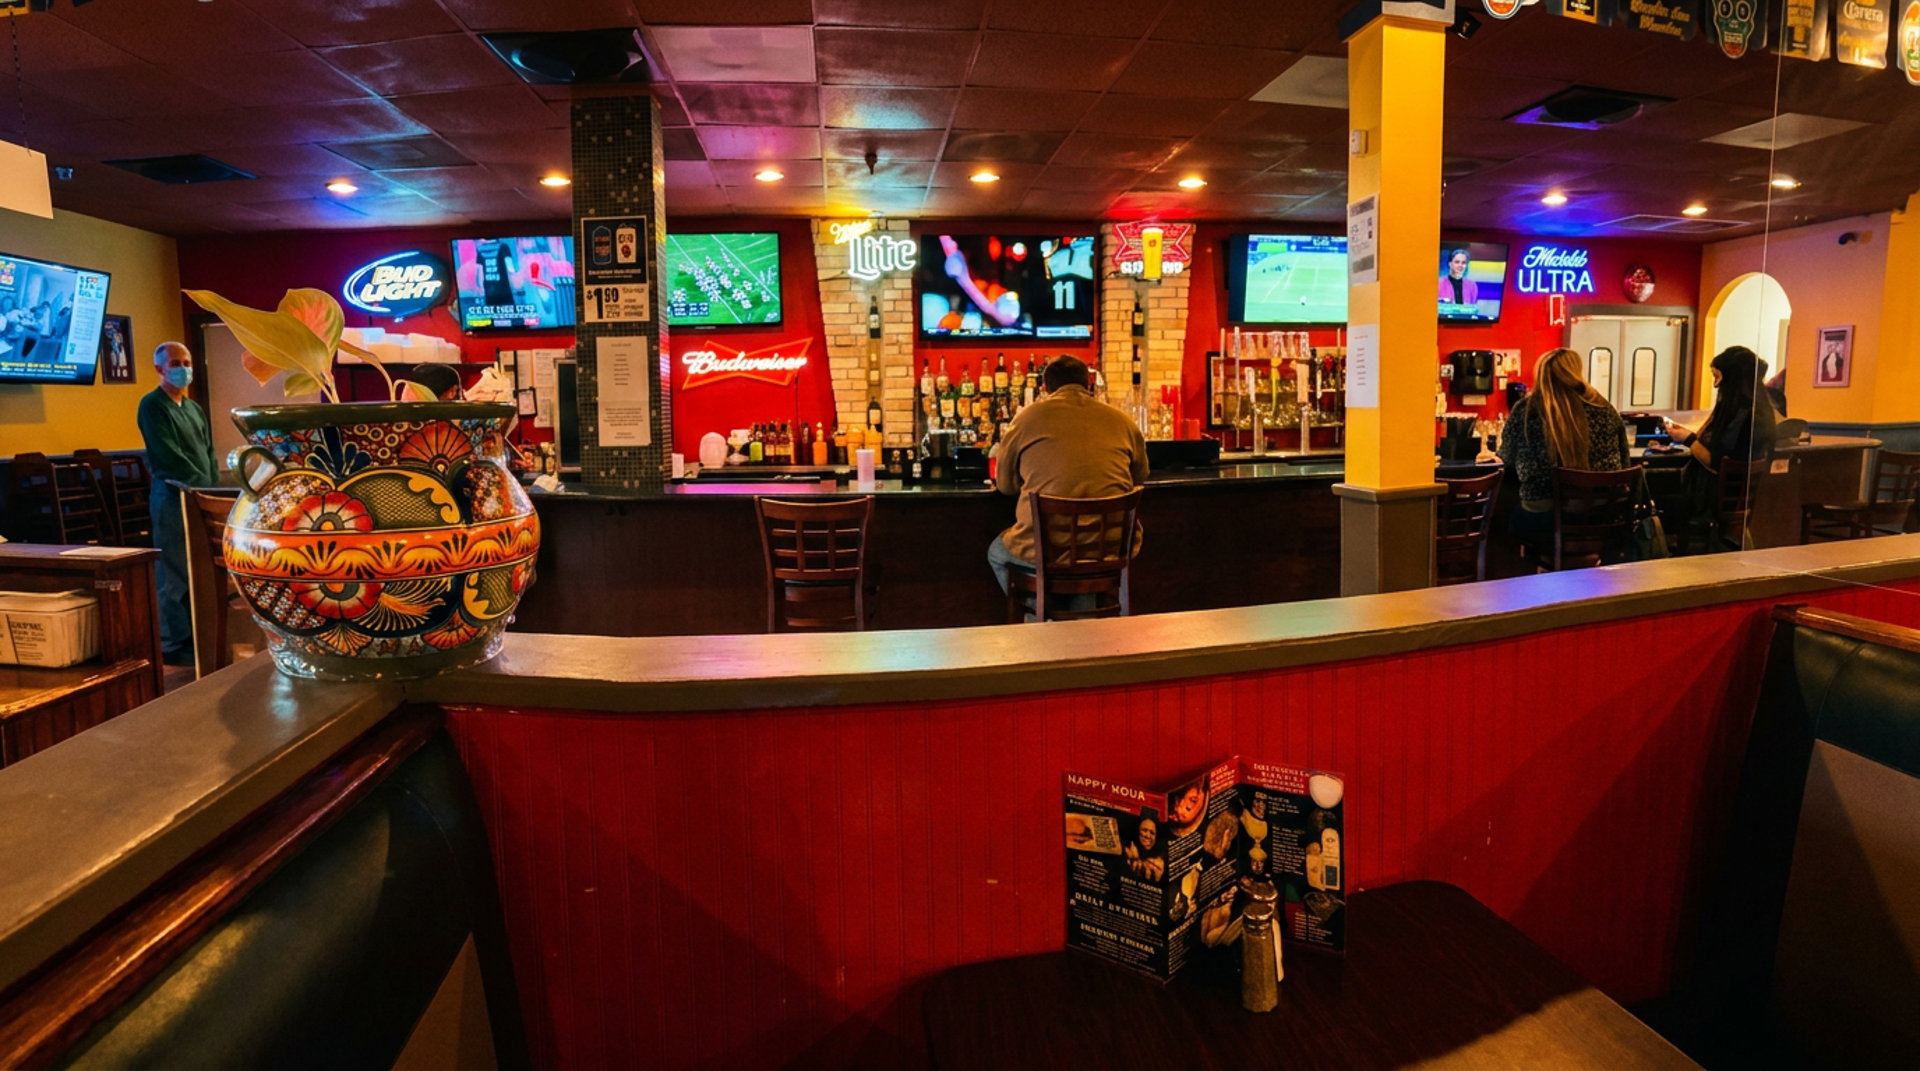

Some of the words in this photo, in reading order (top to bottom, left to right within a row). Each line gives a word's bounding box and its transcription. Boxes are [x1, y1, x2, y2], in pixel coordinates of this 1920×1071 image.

[847, 235, 917, 281] Lite
[371, 265, 434, 285] BUD
[1518, 268, 1594, 293] ULTRA
[360, 280, 442, 303] LIGHT
[682, 350, 808, 375] Budweiser
[1068, 774, 1107, 791] HAPPY
